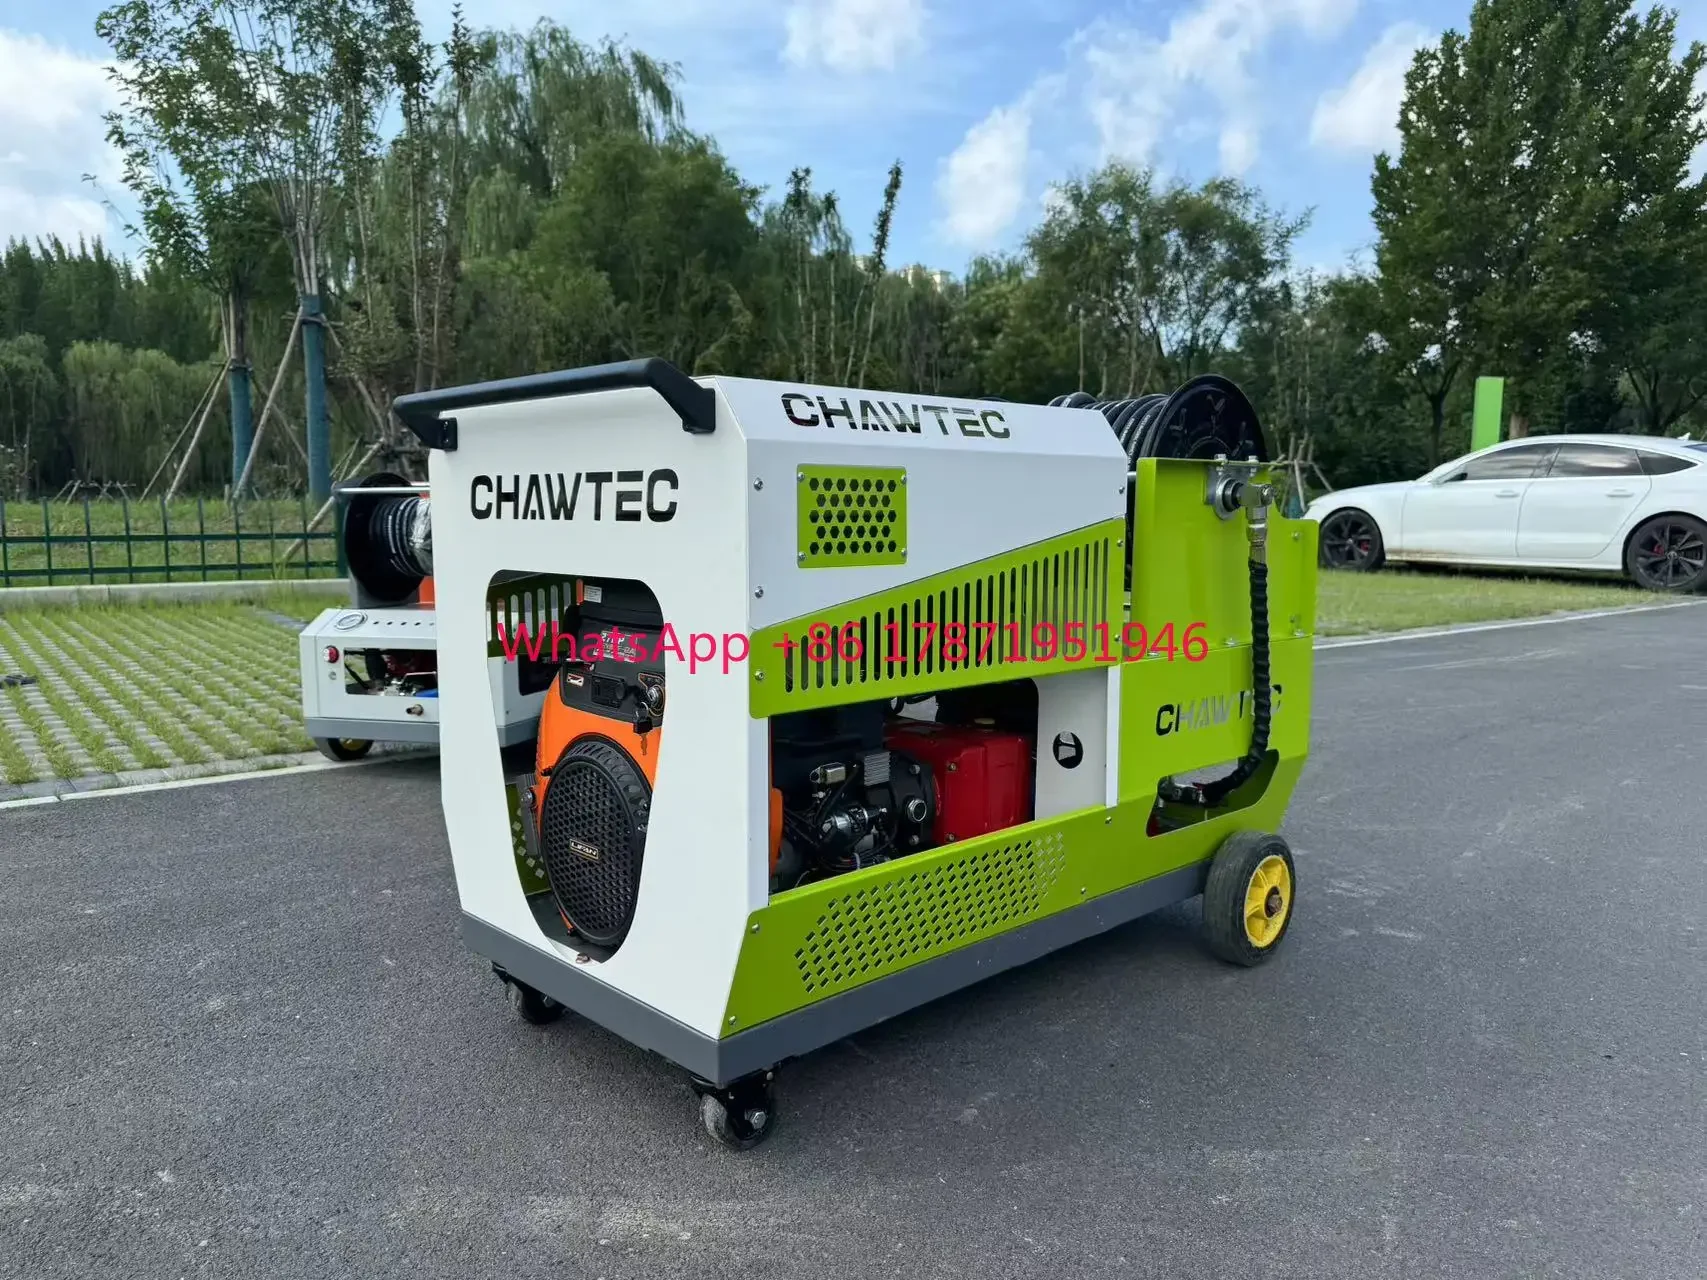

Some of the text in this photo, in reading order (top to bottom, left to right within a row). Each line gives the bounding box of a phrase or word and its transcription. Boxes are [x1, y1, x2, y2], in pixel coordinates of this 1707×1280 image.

[782, 392, 1012, 439] CHAWTEC
[471, 468, 679, 523] CHAWTEC
[1155, 684, 1282, 736] CHAWTC
